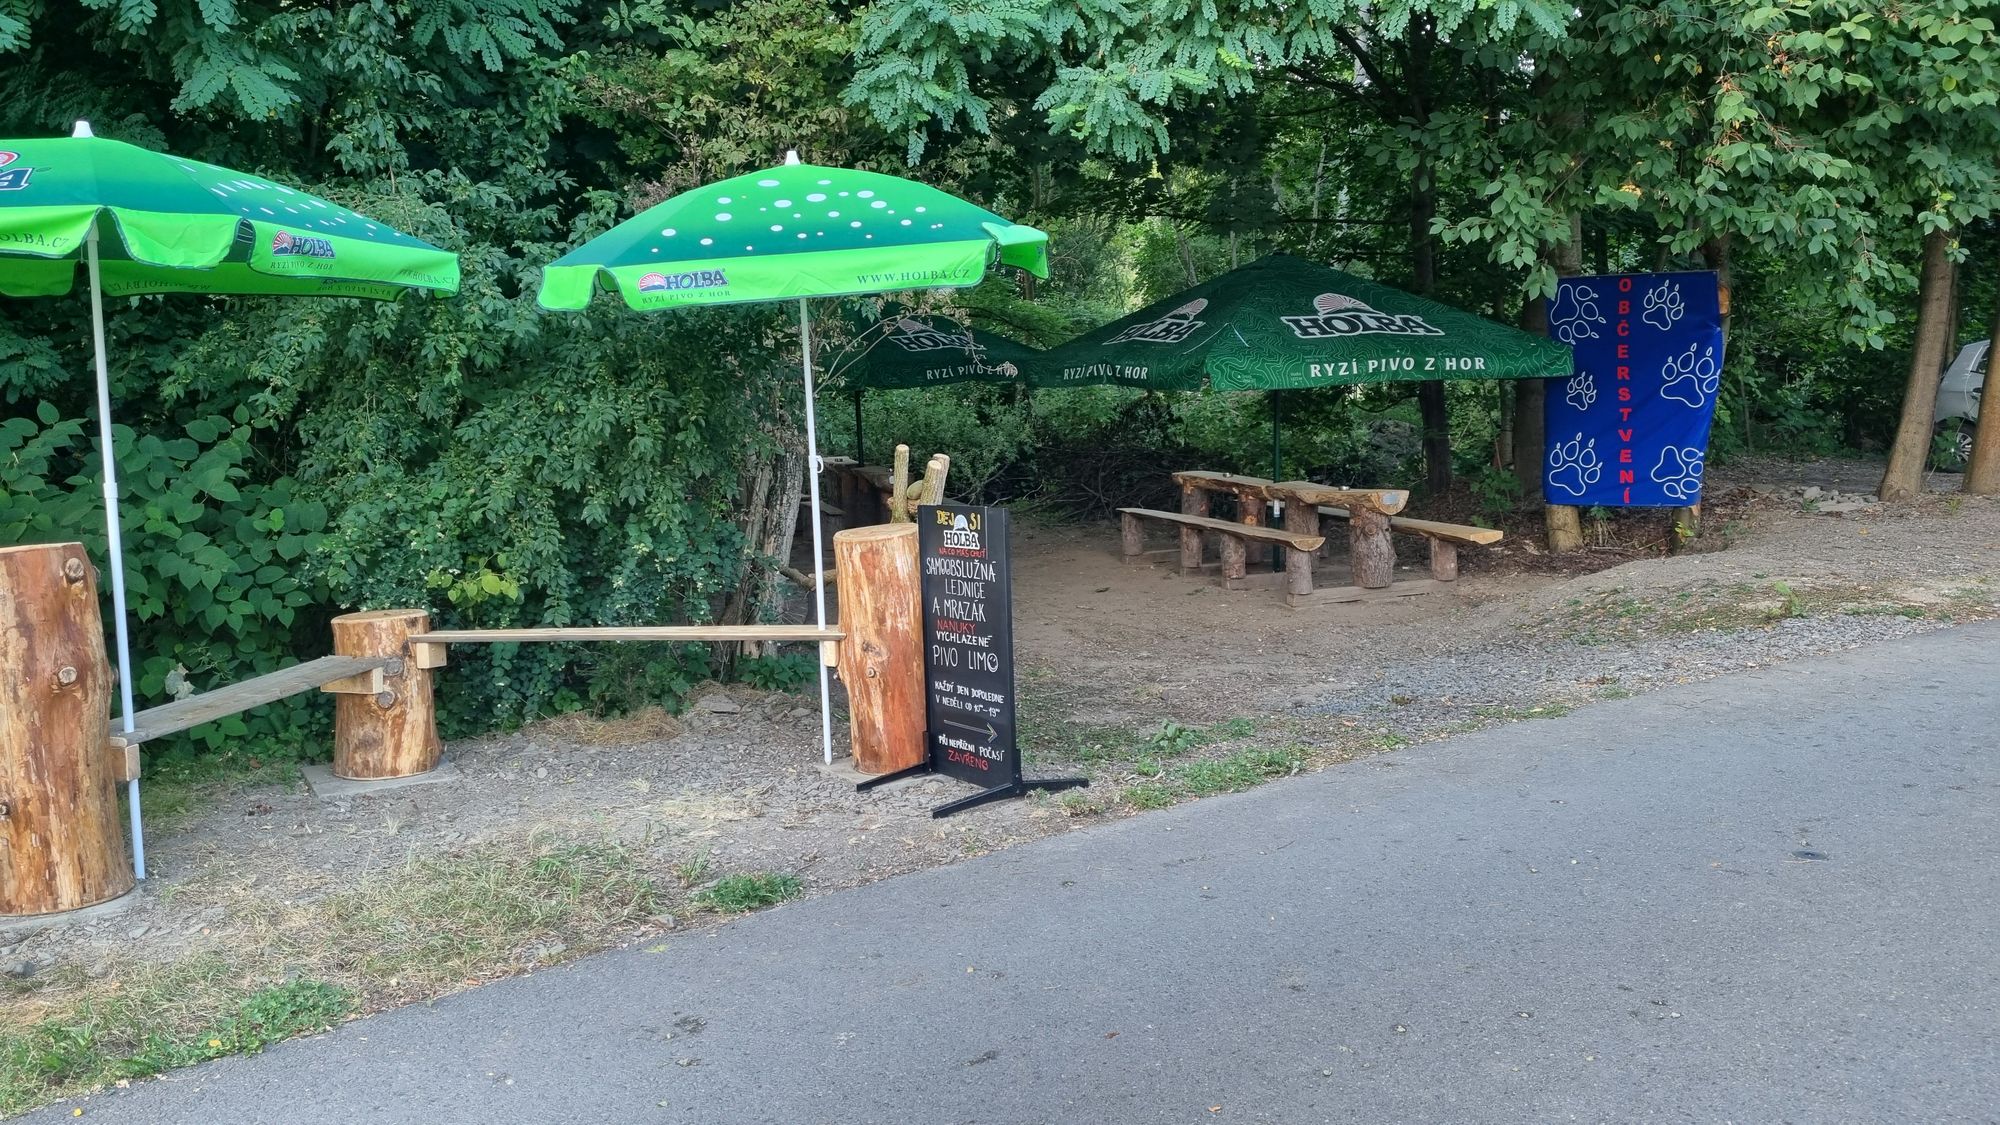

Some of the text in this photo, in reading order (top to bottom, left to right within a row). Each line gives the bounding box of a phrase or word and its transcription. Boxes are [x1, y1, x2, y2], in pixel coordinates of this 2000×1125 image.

[290, 236, 336, 258] HOLBA
[664, 269, 728, 290] HOLBA
[857, 268, 970, 285] WWW.HOLBA.CZ
[642, 295, 665, 304] RYZÍ
[1281, 314, 1446, 338] HOLBA
[926, 365, 953, 380] RYZÍ
[958, 364, 984, 376] PIVO
[1063, 363, 1149, 380] RYZÍ PIVO Z HOR
[1310, 358, 1358, 378] RYZÍ
[1368, 357, 1415, 373] PIVO
[1424, 357, 1436, 371] Z
[1445, 357, 1486, 370] HOR
[1617, 278, 1634, 504] OBČERSTVENÍ
[936, 510, 981, 530] DEJ SI
[944, 530, 980, 549] HOLBA
[926, 557, 997, 583] SAMOOBSLUŽNÁ
[945, 578, 986, 599] LEDNICE
[932, 596, 987, 622] A MRAZÁK
[937, 619, 976, 635] NANUKY
[936, 630, 993, 648] VYCHLAZENÉ
[932, 645, 999, 672] PIVO LIMO
[934, 680, 1005, 704] KAŽDÝ DEN DOPOLEDNE
[935, 694, 941, 703] V
[942, 696, 963, 709] NEDĚLI
[965, 702, 973, 711] OD
[948, 749, 989, 771] ZAVŘENO
[949, 739, 976, 753] NEPŘÍZNI
[979, 746, 1005, 762] POČASÍ
